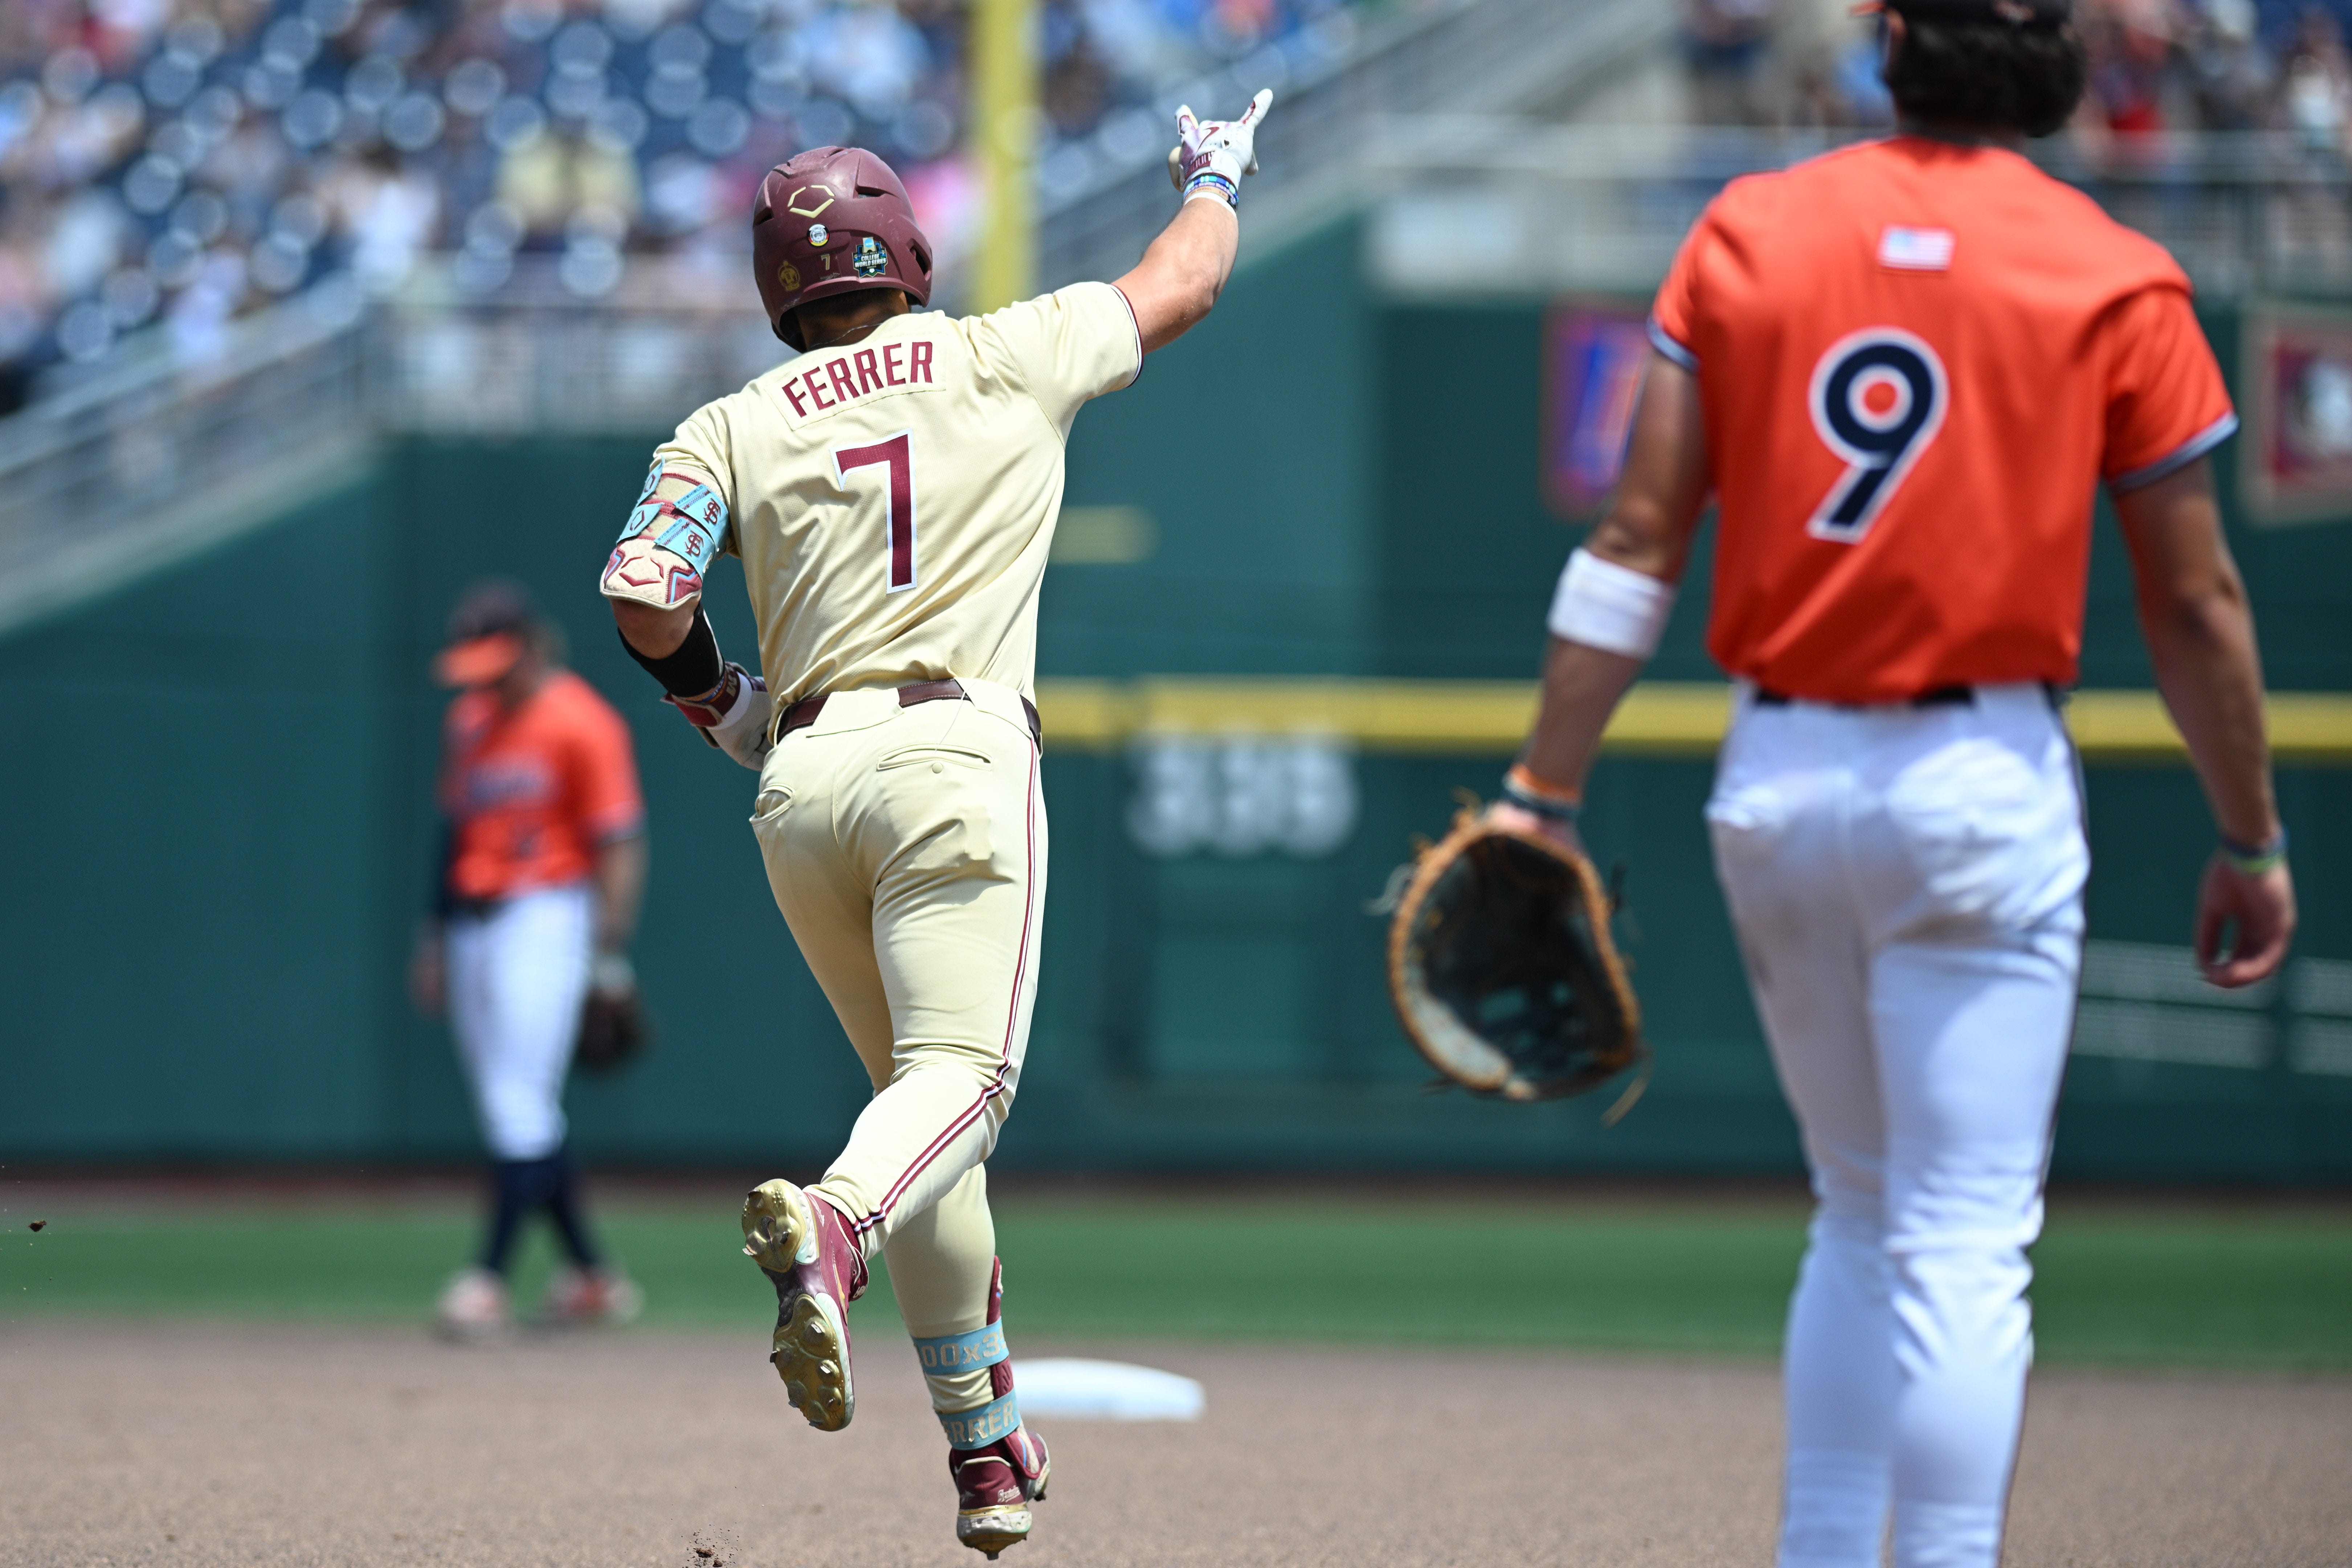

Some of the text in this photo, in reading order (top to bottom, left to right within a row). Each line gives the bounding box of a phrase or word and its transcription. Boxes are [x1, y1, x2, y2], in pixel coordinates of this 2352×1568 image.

[821, 254, 830, 270] 7
[861, 253, 880, 262] COLLEGE
[782, 341, 933, 418] FERRER
[1806, 325, 1950, 544] 9
[830, 428, 917, 594] 7
